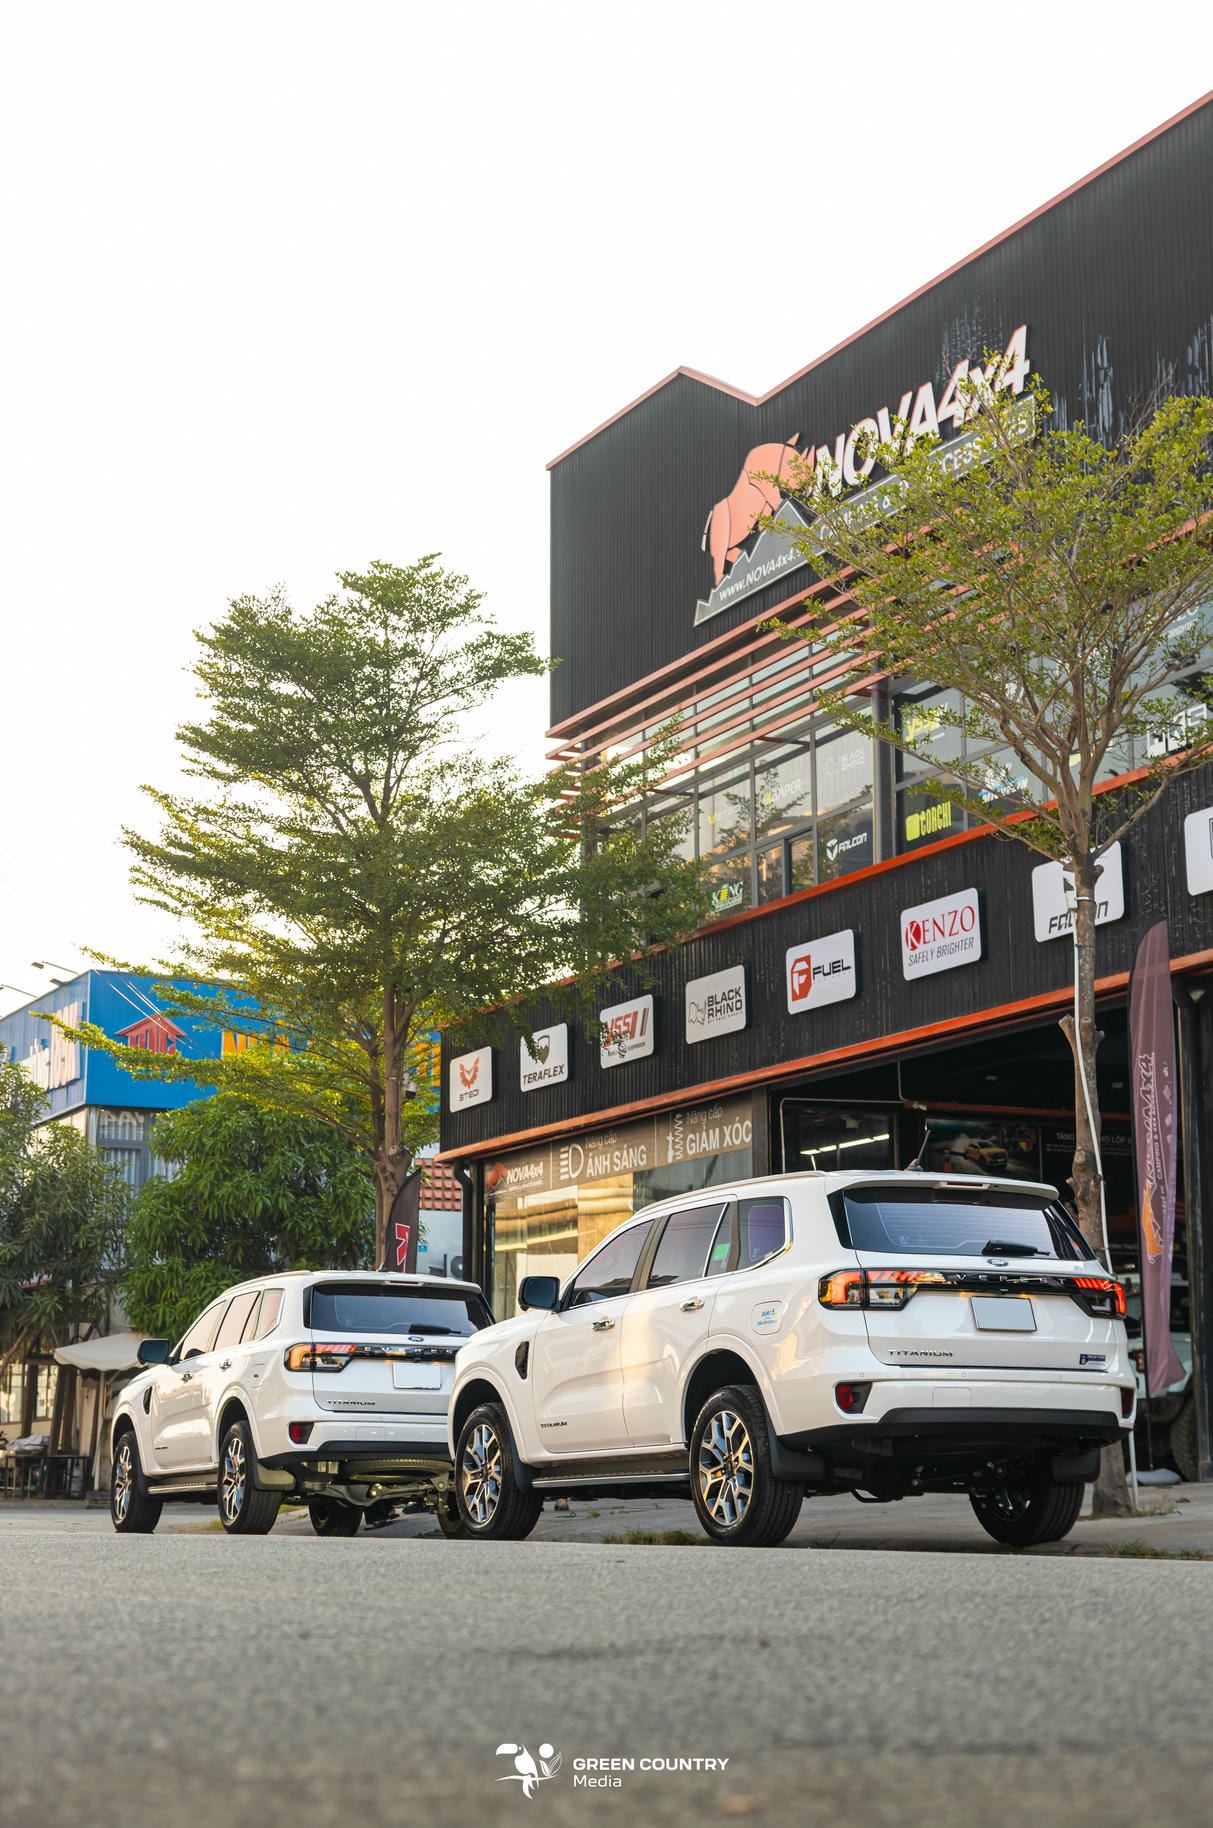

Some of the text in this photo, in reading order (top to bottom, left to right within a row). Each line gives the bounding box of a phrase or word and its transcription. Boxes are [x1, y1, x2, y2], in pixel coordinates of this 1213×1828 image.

[904, 905, 976, 951] KENZO
[908, 936, 974, 967] SAFELY BRIGHTER
[812, 958, 851, 980] FUEL
[707, 986, 742, 1007] BLACK
[707, 999, 743, 1020] RHINO
[522, 1064, 565, 1085] TERAFLEX
[459, 1088, 480, 1102] STEDI
[686, 1116, 753, 1156] GIẢM XÓC
[613, 1143, 647, 1172] SÁNG
[506, 1161, 544, 1185] NOVA4x4
[887, 1348, 954, 1358] TITANIUM
[328, 1399, 376, 1407] TITANIUM
